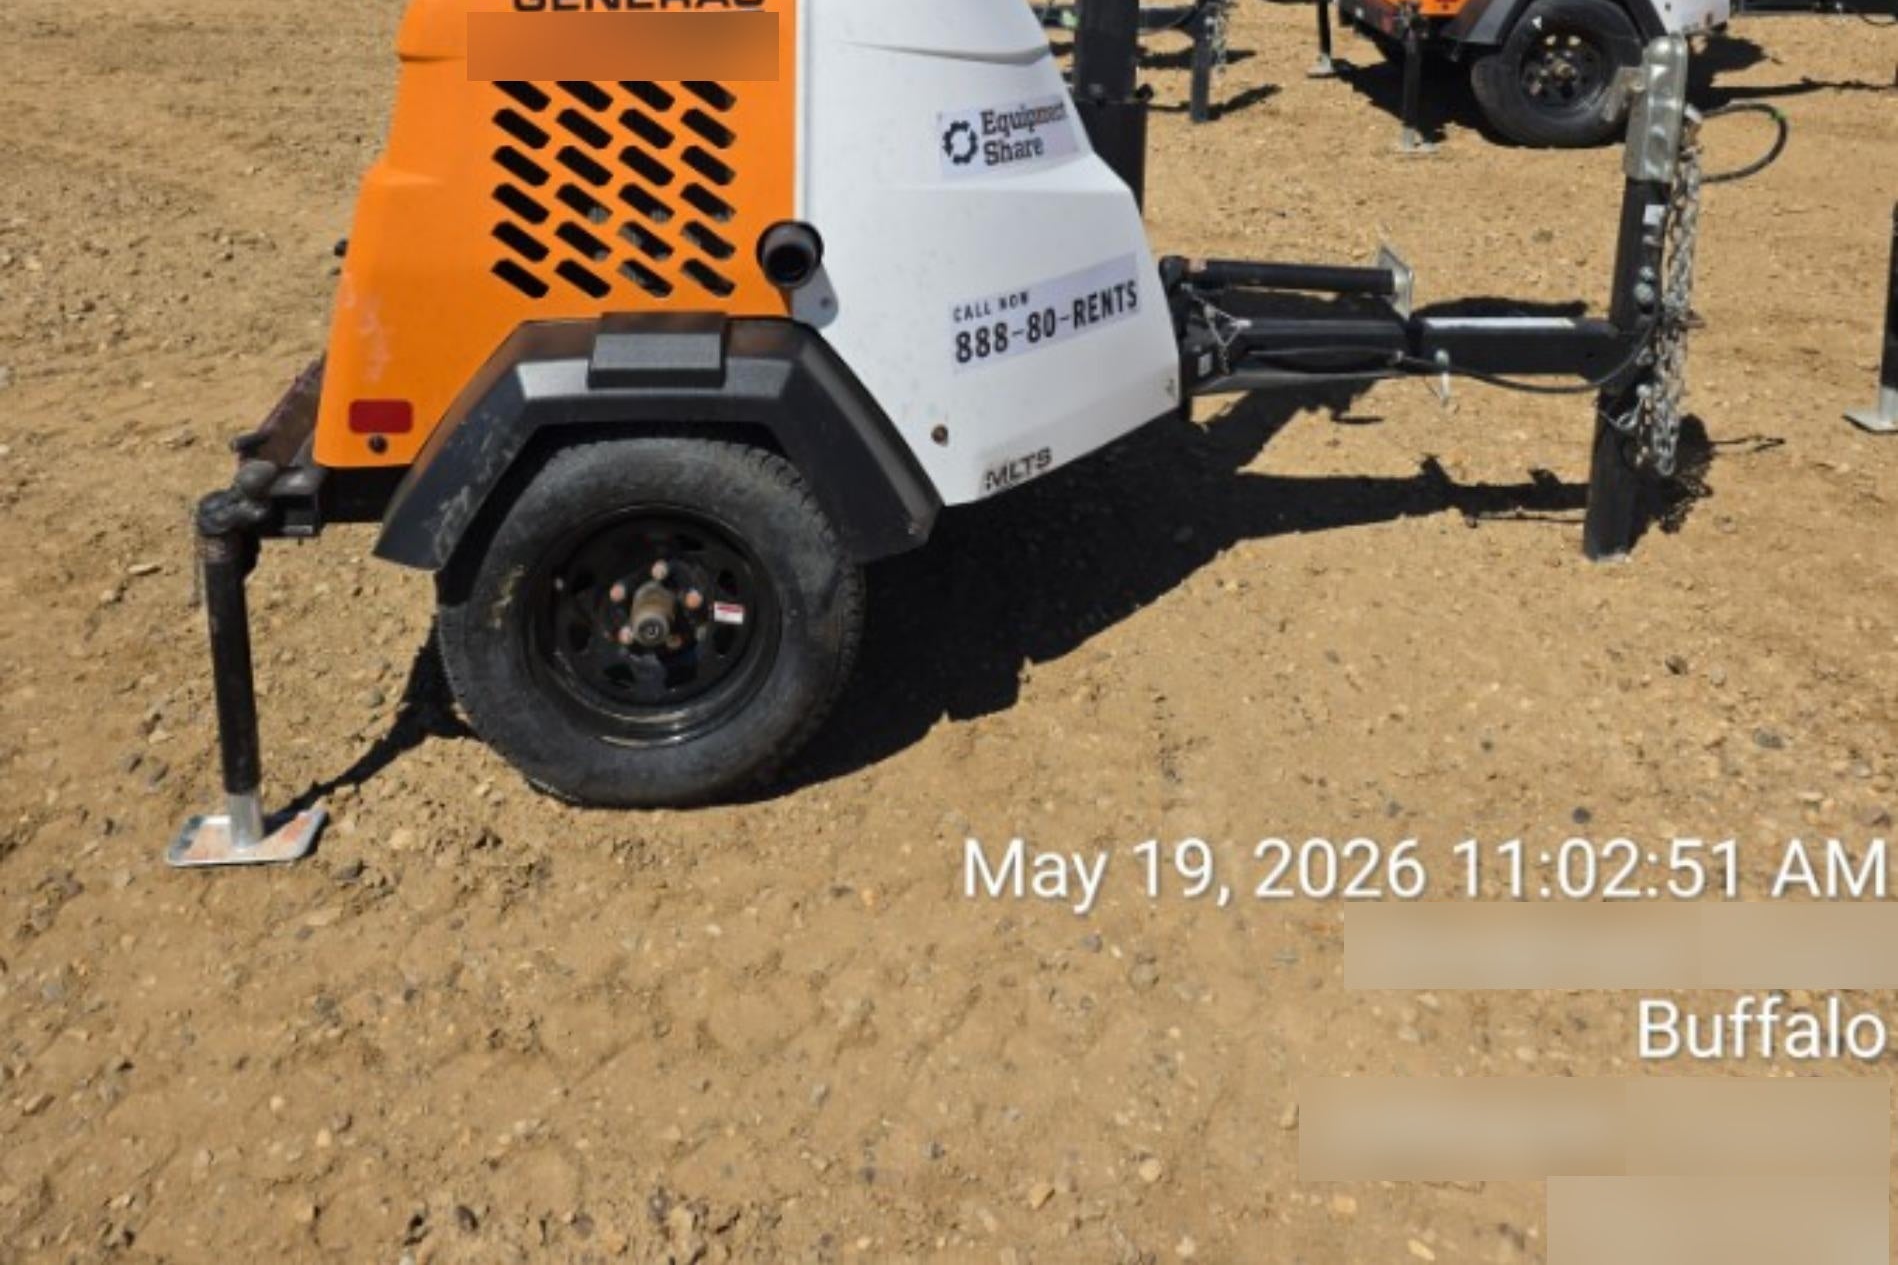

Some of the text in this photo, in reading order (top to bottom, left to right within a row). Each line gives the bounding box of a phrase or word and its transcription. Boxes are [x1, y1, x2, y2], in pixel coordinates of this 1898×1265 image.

[983, 137, 1045, 166] Share
[954, 302, 991, 323] CALL
[955, 280, 1138, 364] 888-80-RENTS
